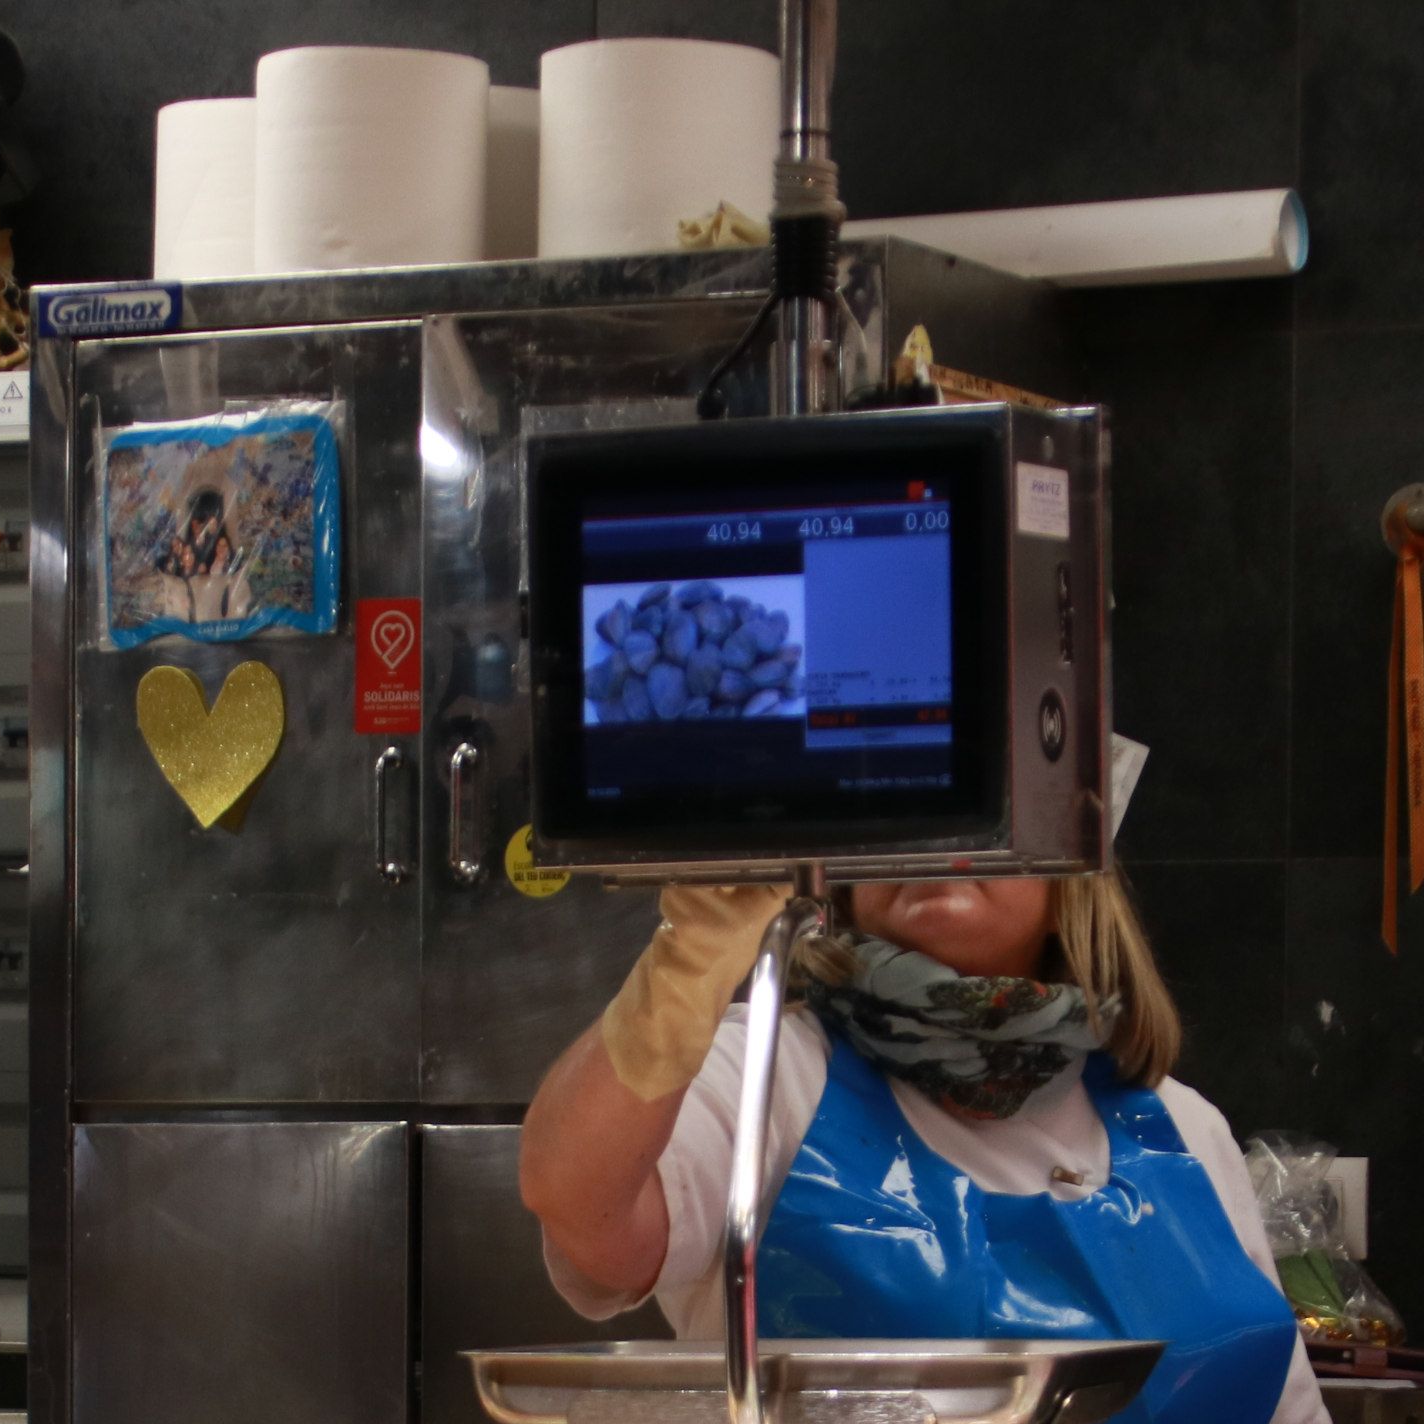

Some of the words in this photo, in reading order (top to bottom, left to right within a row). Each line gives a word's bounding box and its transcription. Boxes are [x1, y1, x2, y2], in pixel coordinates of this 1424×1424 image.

[54, 296, 164, 326] Galimax
[706, 522, 762, 543] 40,94
[799, 516, 854, 537] 40,94
[905, 510, 949, 533] 0,00
[363, 690, 421, 702] SOLIDARIS
